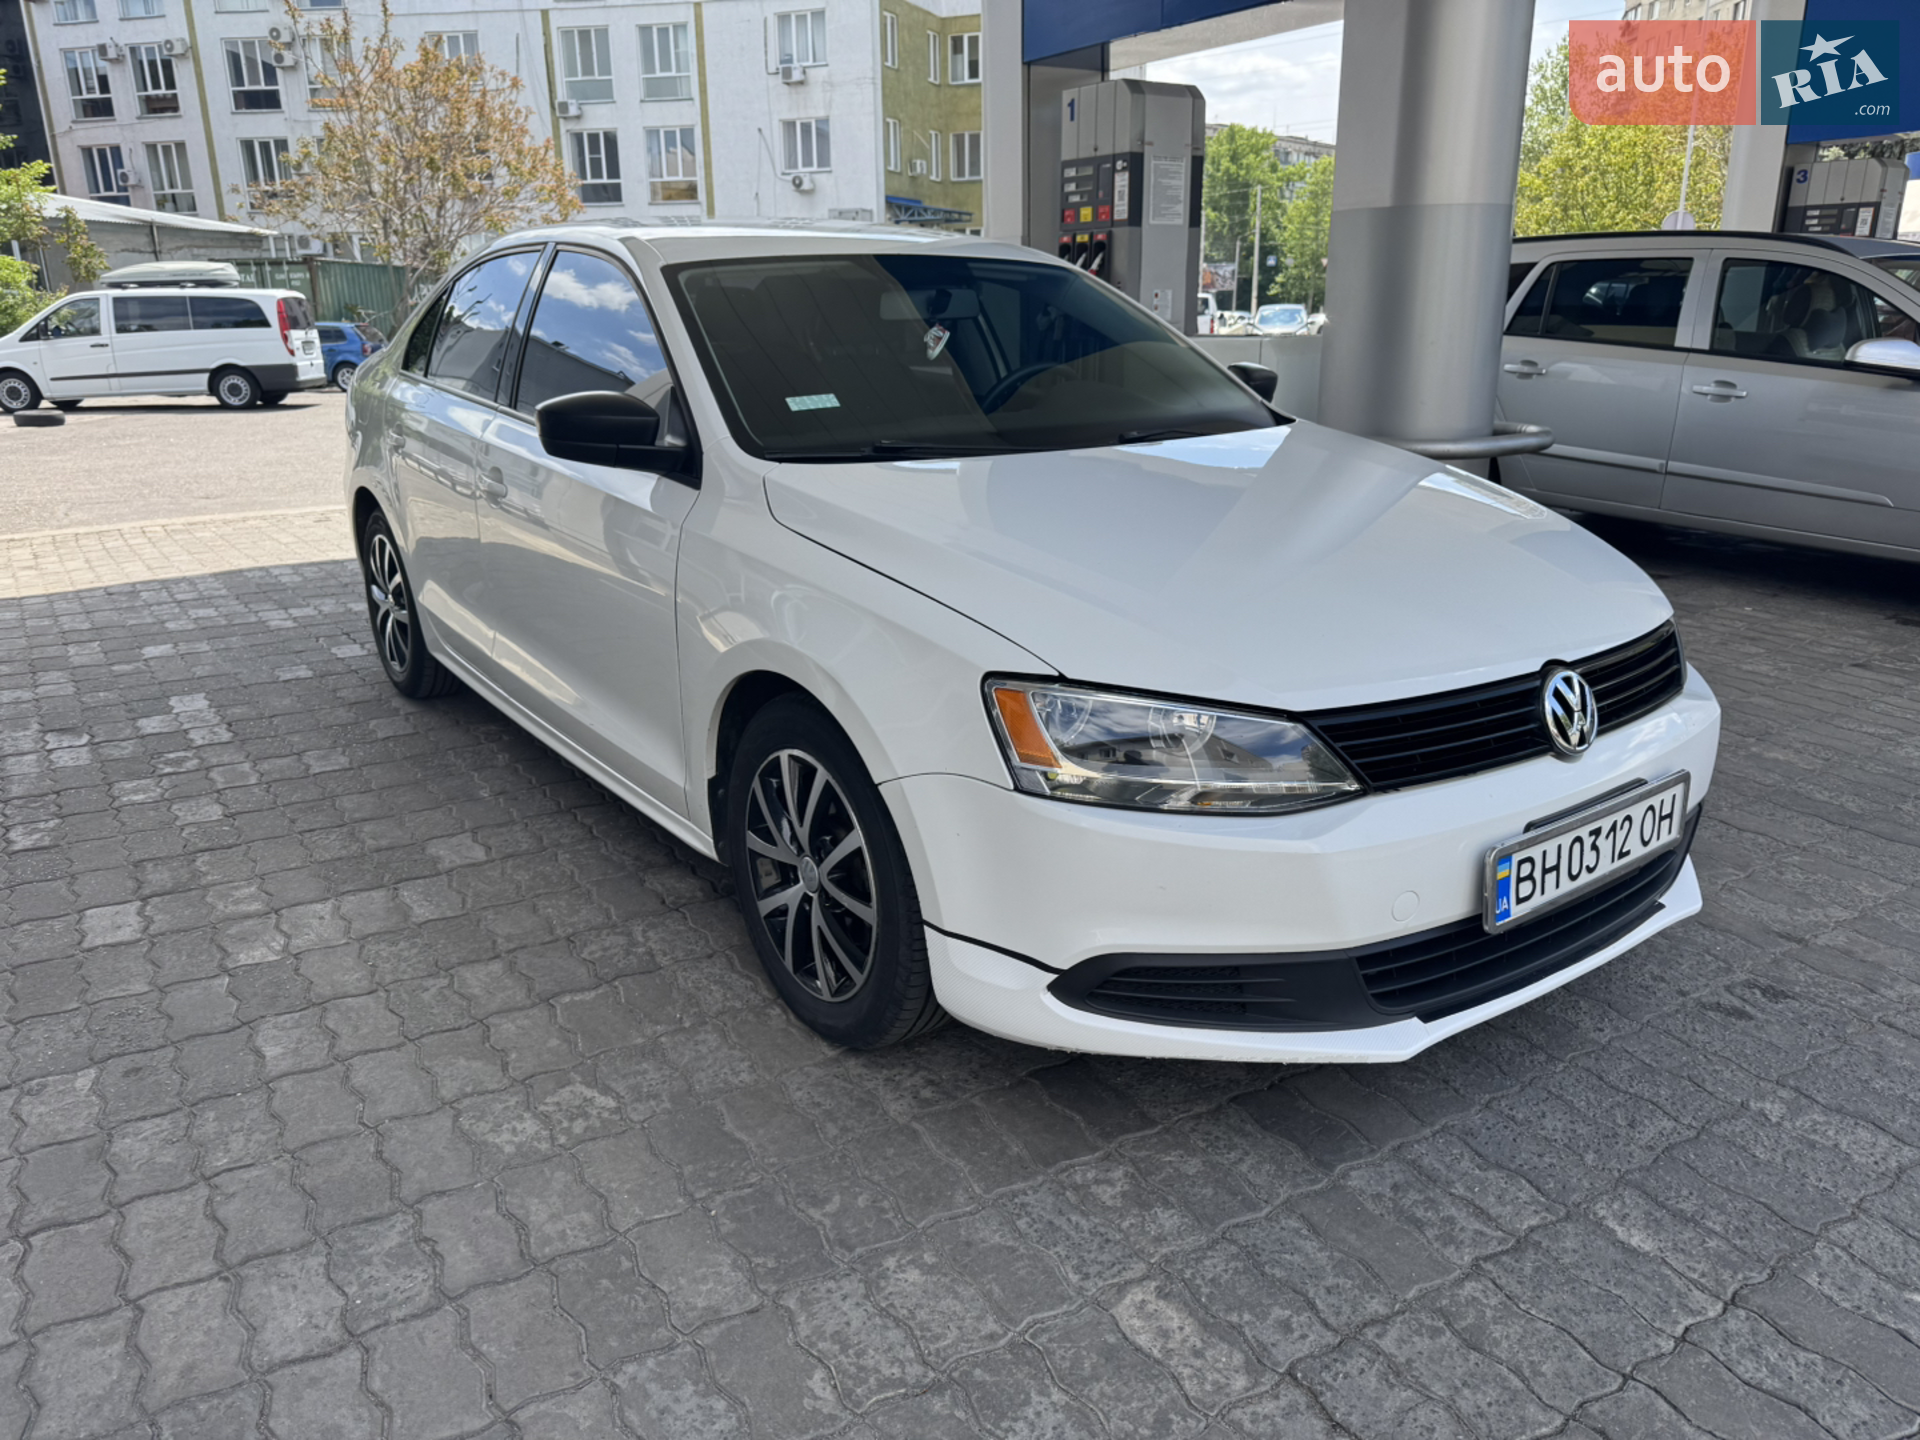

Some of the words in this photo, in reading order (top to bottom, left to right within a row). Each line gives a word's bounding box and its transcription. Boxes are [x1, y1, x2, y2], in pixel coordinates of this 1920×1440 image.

[1067, 97, 1076, 122] 1
[1795, 168, 1809, 184] 3
[1640, 793, 1677, 847] OH
